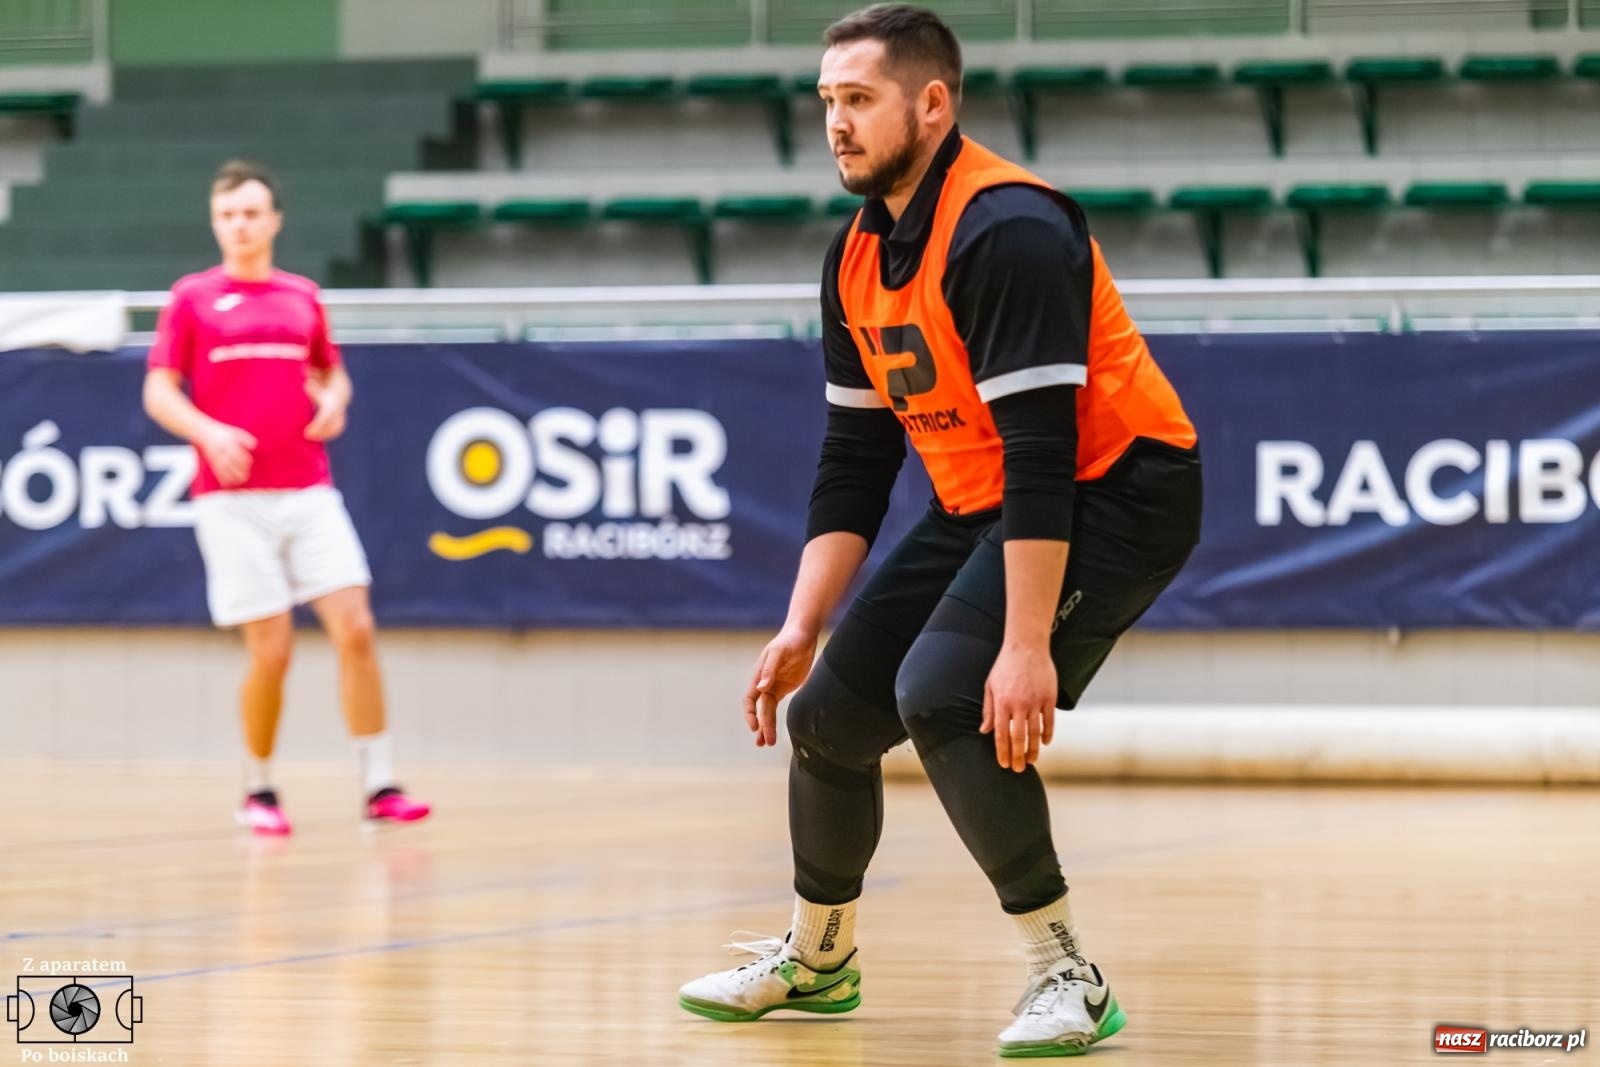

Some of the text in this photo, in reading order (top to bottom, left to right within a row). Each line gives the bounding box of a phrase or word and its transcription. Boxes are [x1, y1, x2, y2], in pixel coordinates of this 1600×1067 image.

[426, 406, 731, 520] OSiR
[902, 408, 967, 433] ATRICK
[0, 419, 197, 530] ÓRZ
[1255, 438, 1600, 526] RACIB
[543, 515, 732, 560] RACIBÓRZ
